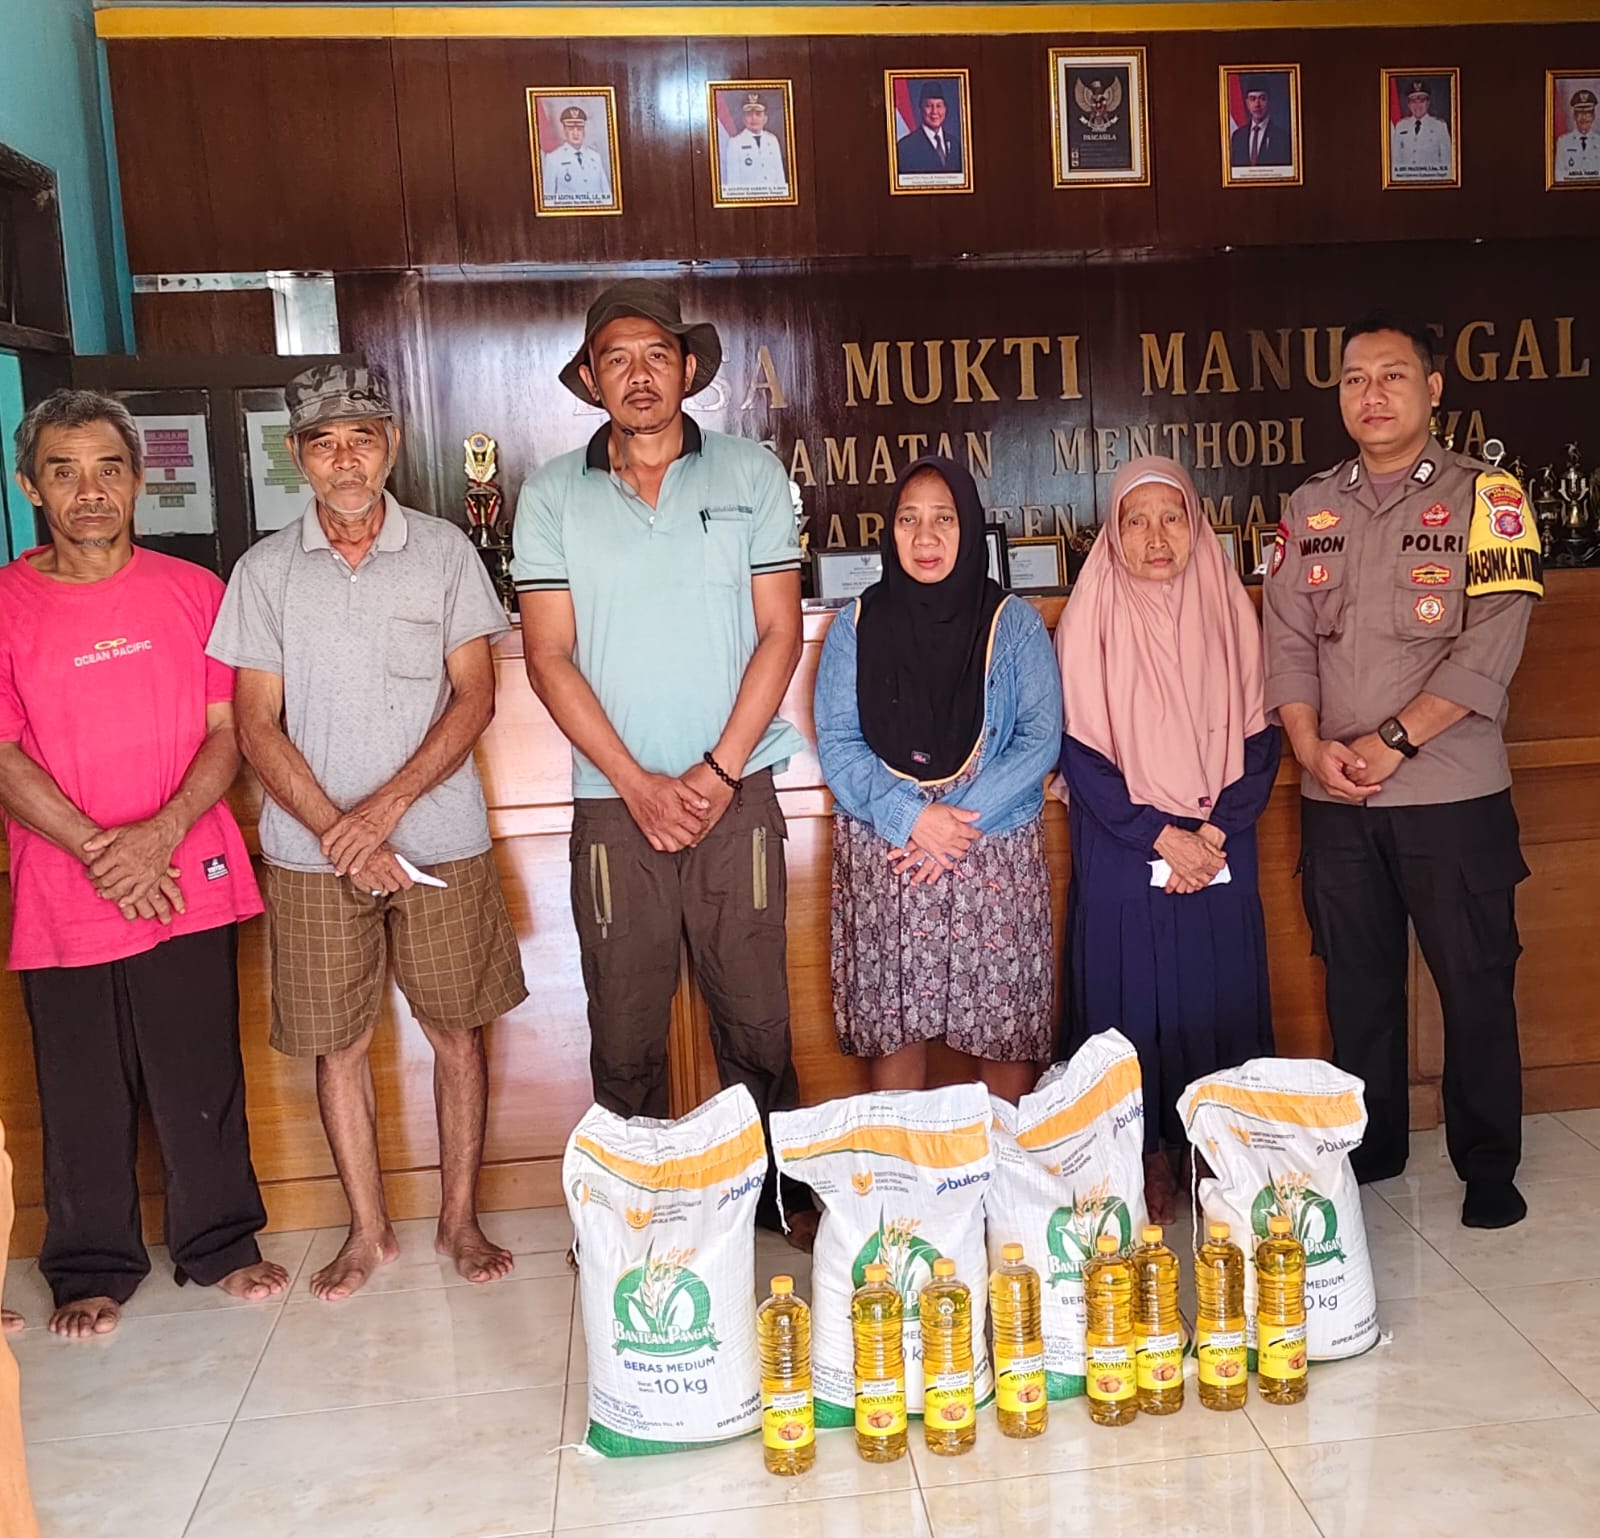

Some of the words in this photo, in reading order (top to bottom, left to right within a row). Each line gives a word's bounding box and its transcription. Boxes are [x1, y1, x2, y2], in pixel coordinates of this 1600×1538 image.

[842, 336, 1082, 406] MUKTI
[1140, 317, 1590, 396] MANUGAL
[1051, 417, 1307, 477] MENTHOBI
[1402, 534, 1463, 553] POLRI
[74, 651, 110, 667] OCEAN
[112, 640, 152, 658] PACIFIC
[947, 1171, 991, 1190] bulog
[1049, 1255, 1084, 1273] BANT
[1306, 1275, 1345, 1289] MEDIUM
[1062, 1296, 1084, 1305] BER
[1319, 1294, 1338, 1310] kg
[613, 1319, 667, 1344] BANTUAN
[667, 1322, 717, 1344] PANGAN
[624, 1360, 663, 1373] BERAS
[667, 1356, 716, 1373] MEDIUM
[655, 1379, 679, 1394] 10
[683, 1378, 708, 1394] kg
